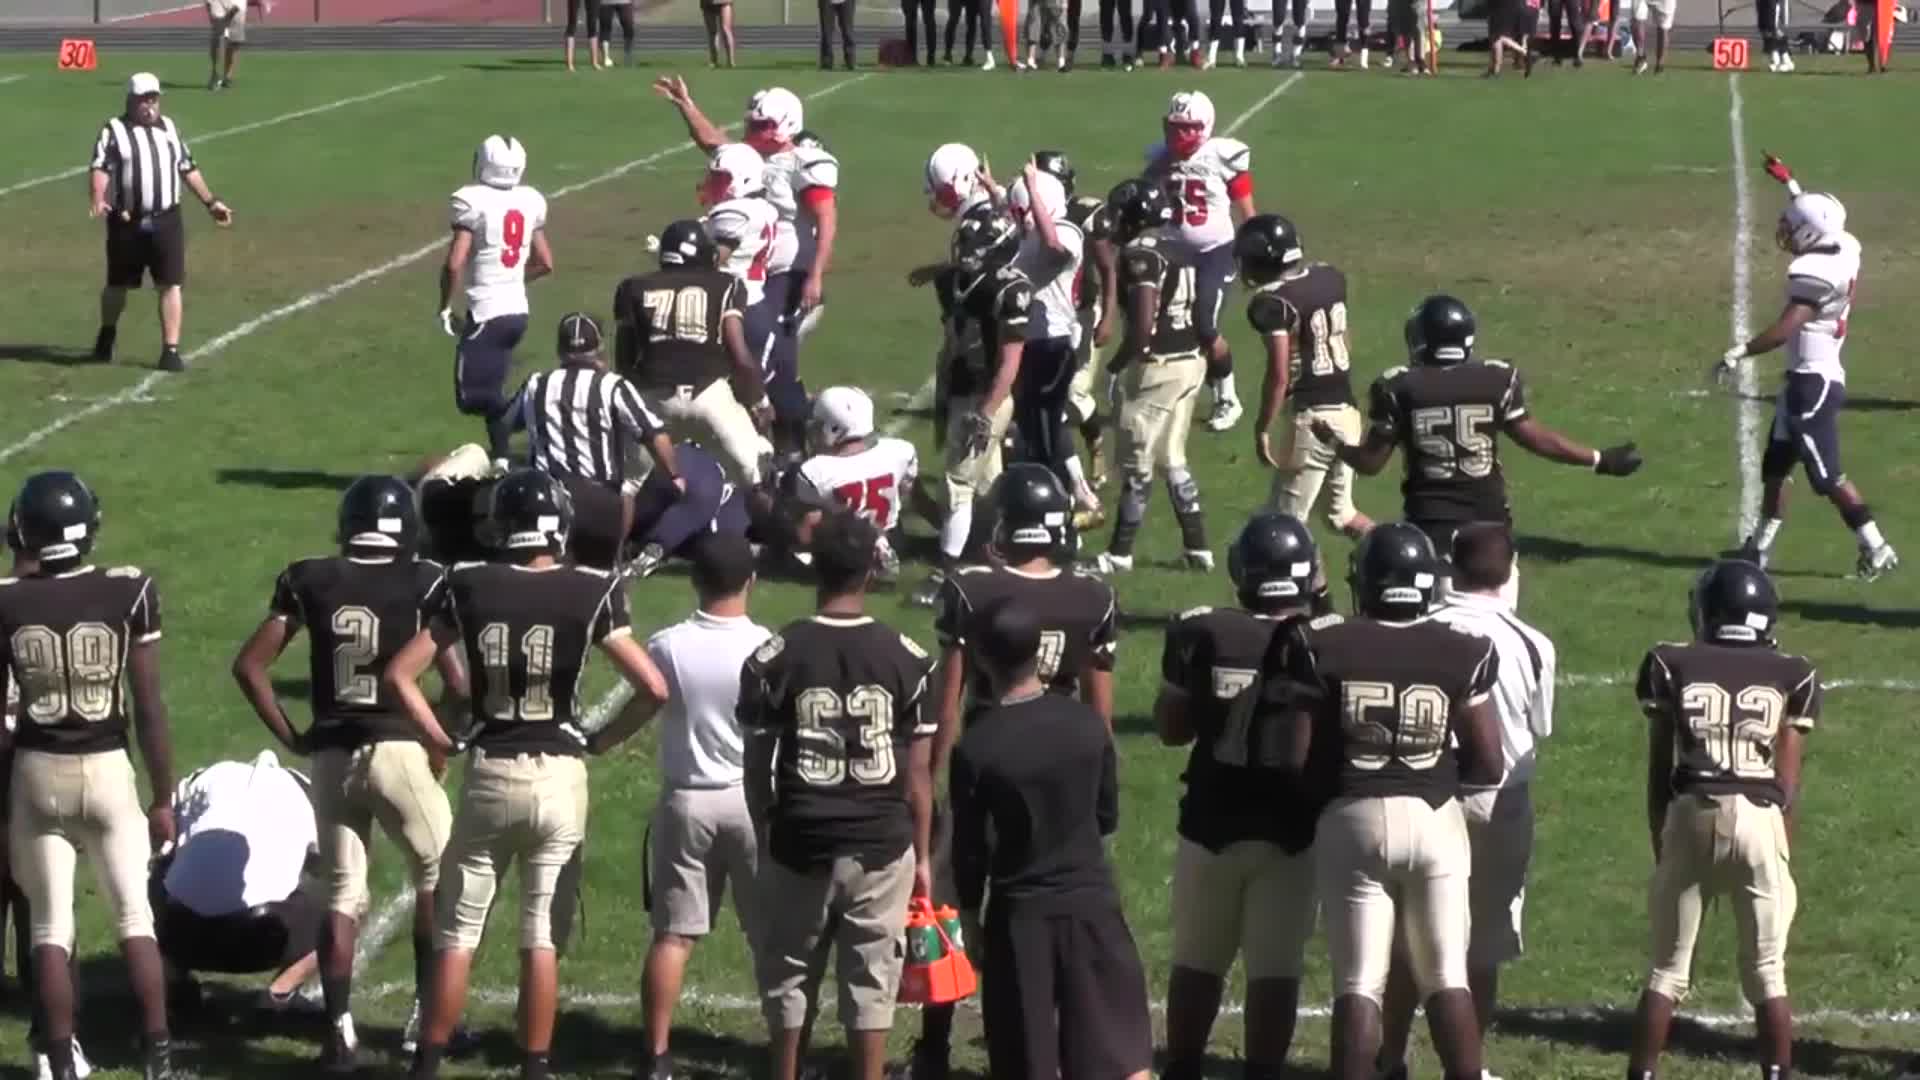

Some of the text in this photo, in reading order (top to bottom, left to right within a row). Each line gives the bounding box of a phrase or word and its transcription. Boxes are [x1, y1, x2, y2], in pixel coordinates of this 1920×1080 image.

[62, 42, 89, 68] 30
[1717, 42, 1744, 67] 50
[501, 208, 525, 269] 9
[643, 286, 708, 343] 70
[1412, 404, 1494, 479] 55
[331, 605, 380, 705] 2
[478, 621, 554, 721] 11
[1681, 682, 1784, 779] 32
